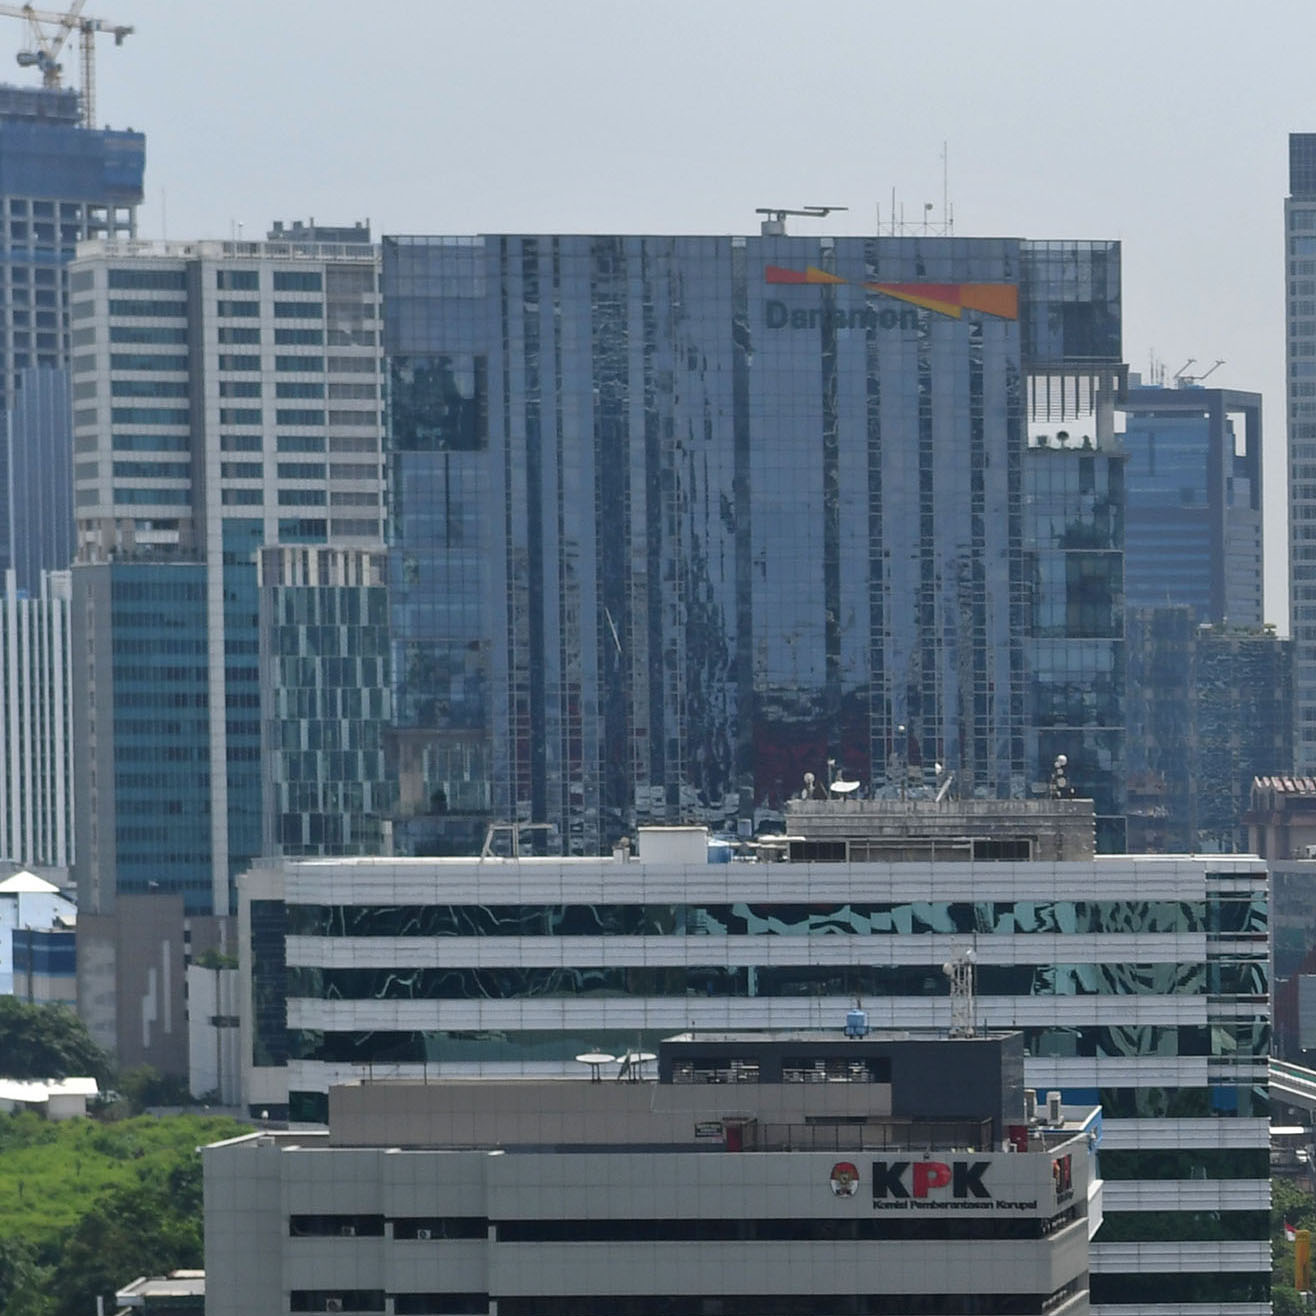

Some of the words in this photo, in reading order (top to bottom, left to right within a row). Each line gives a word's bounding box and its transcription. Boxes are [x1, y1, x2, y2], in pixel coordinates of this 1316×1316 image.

[766, 300, 918, 329] Danamon
[872, 1161, 992, 1198] KPK
[873, 1200, 908, 1210] Komisi
[910, 1200, 993, 1210] Pemberantasan
[996, 1200, 1038, 1211] Korupsi
